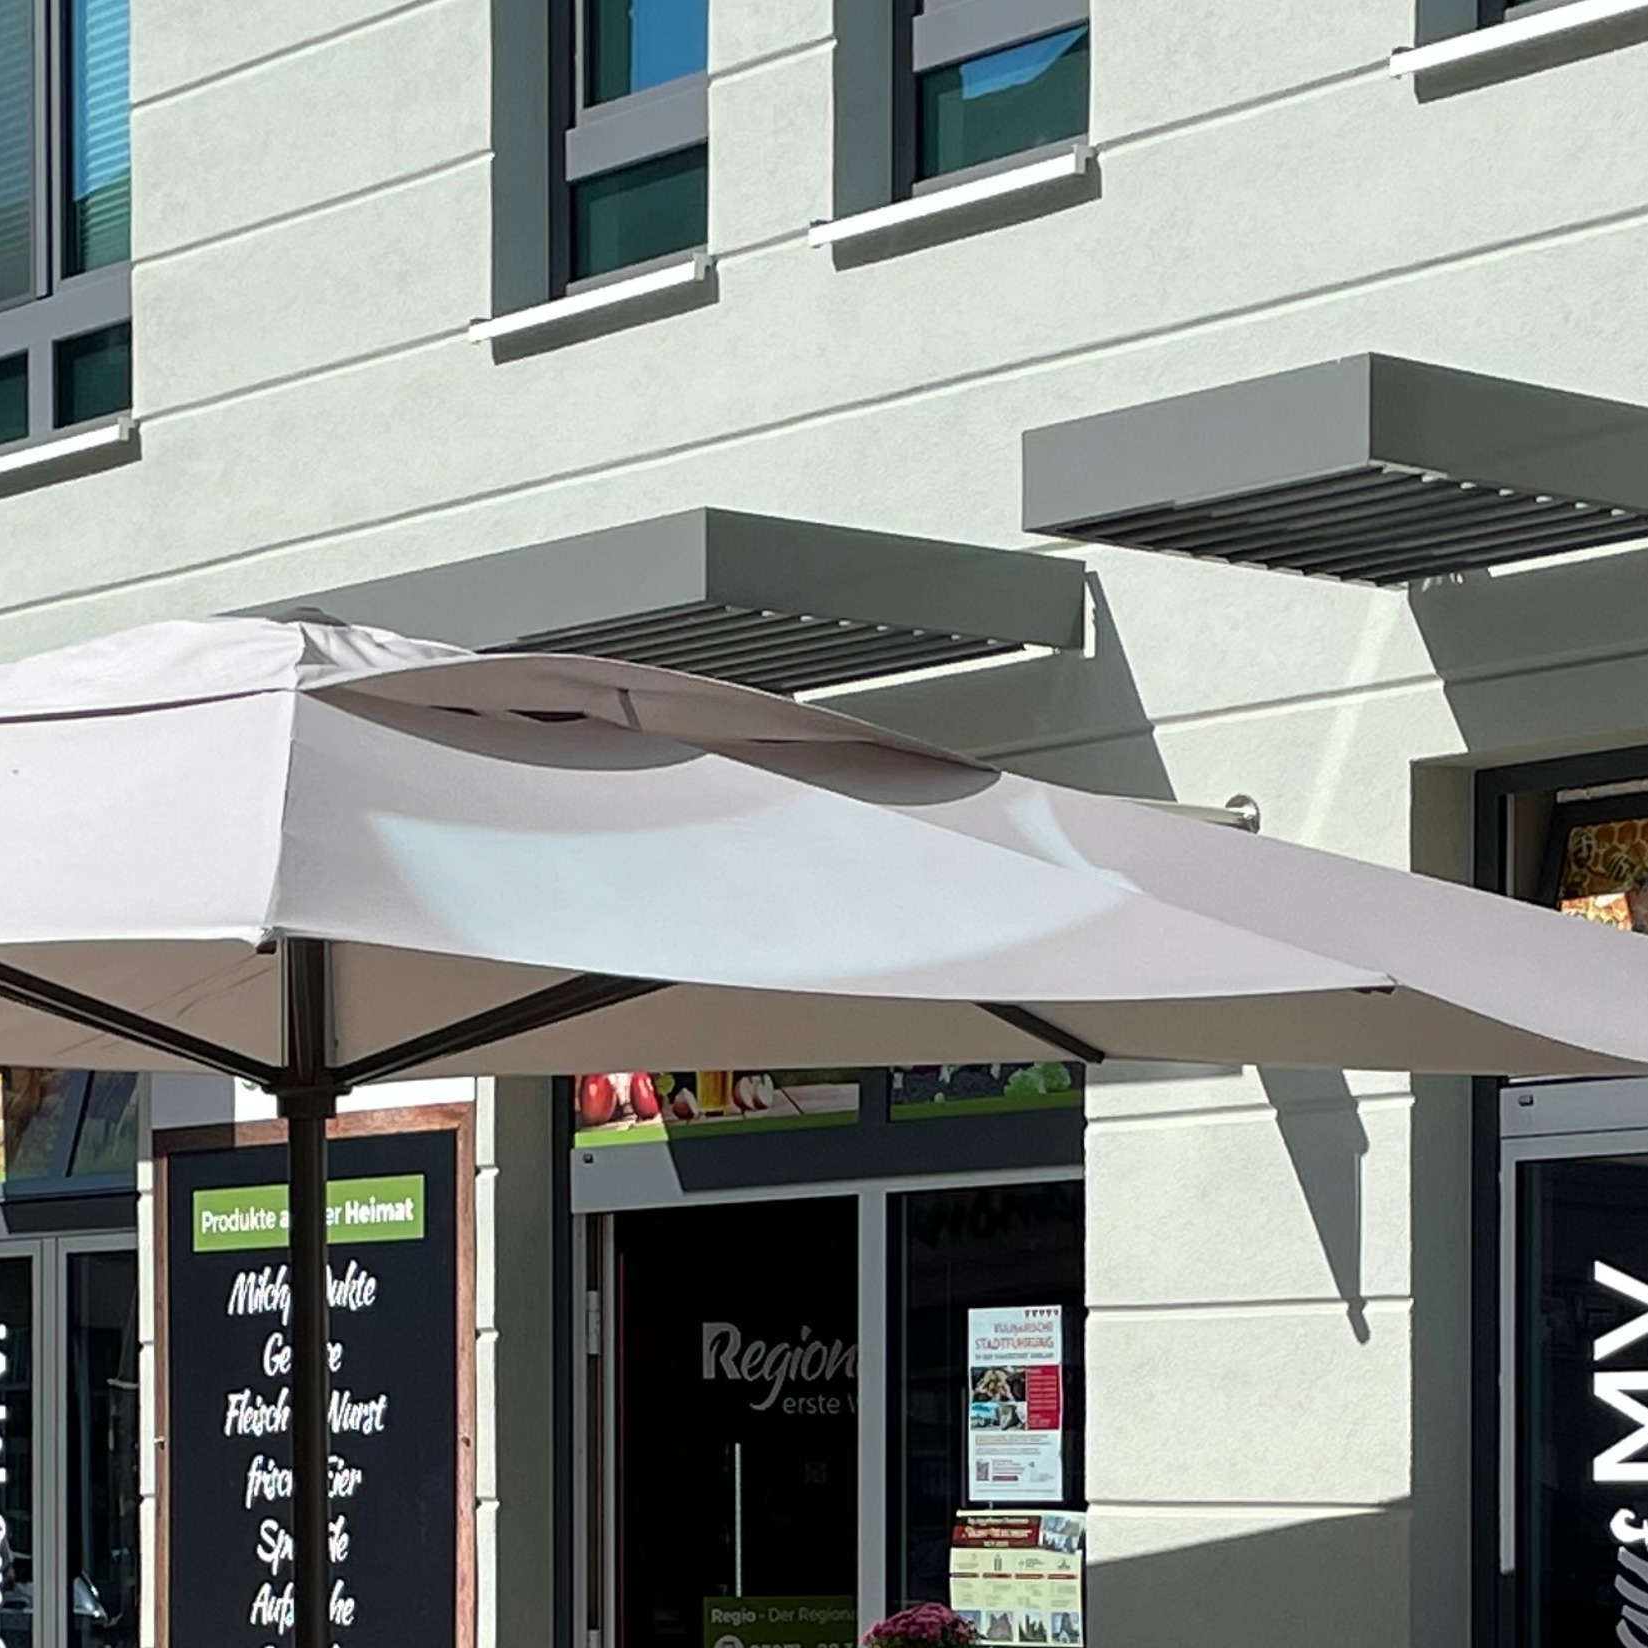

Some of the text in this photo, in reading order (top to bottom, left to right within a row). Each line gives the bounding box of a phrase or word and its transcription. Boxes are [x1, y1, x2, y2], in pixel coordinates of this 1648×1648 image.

[201, 1206, 277, 1234] Produkte
[326, 1206, 341, 1226] er
[344, 1196, 415, 1224] Heimat
[223, 1386, 292, 1437] Fleisch
[781, 1393, 841, 1415] erste
[711, 1607, 757, 1627] Regio
[768, 1606, 795, 1624] Der
